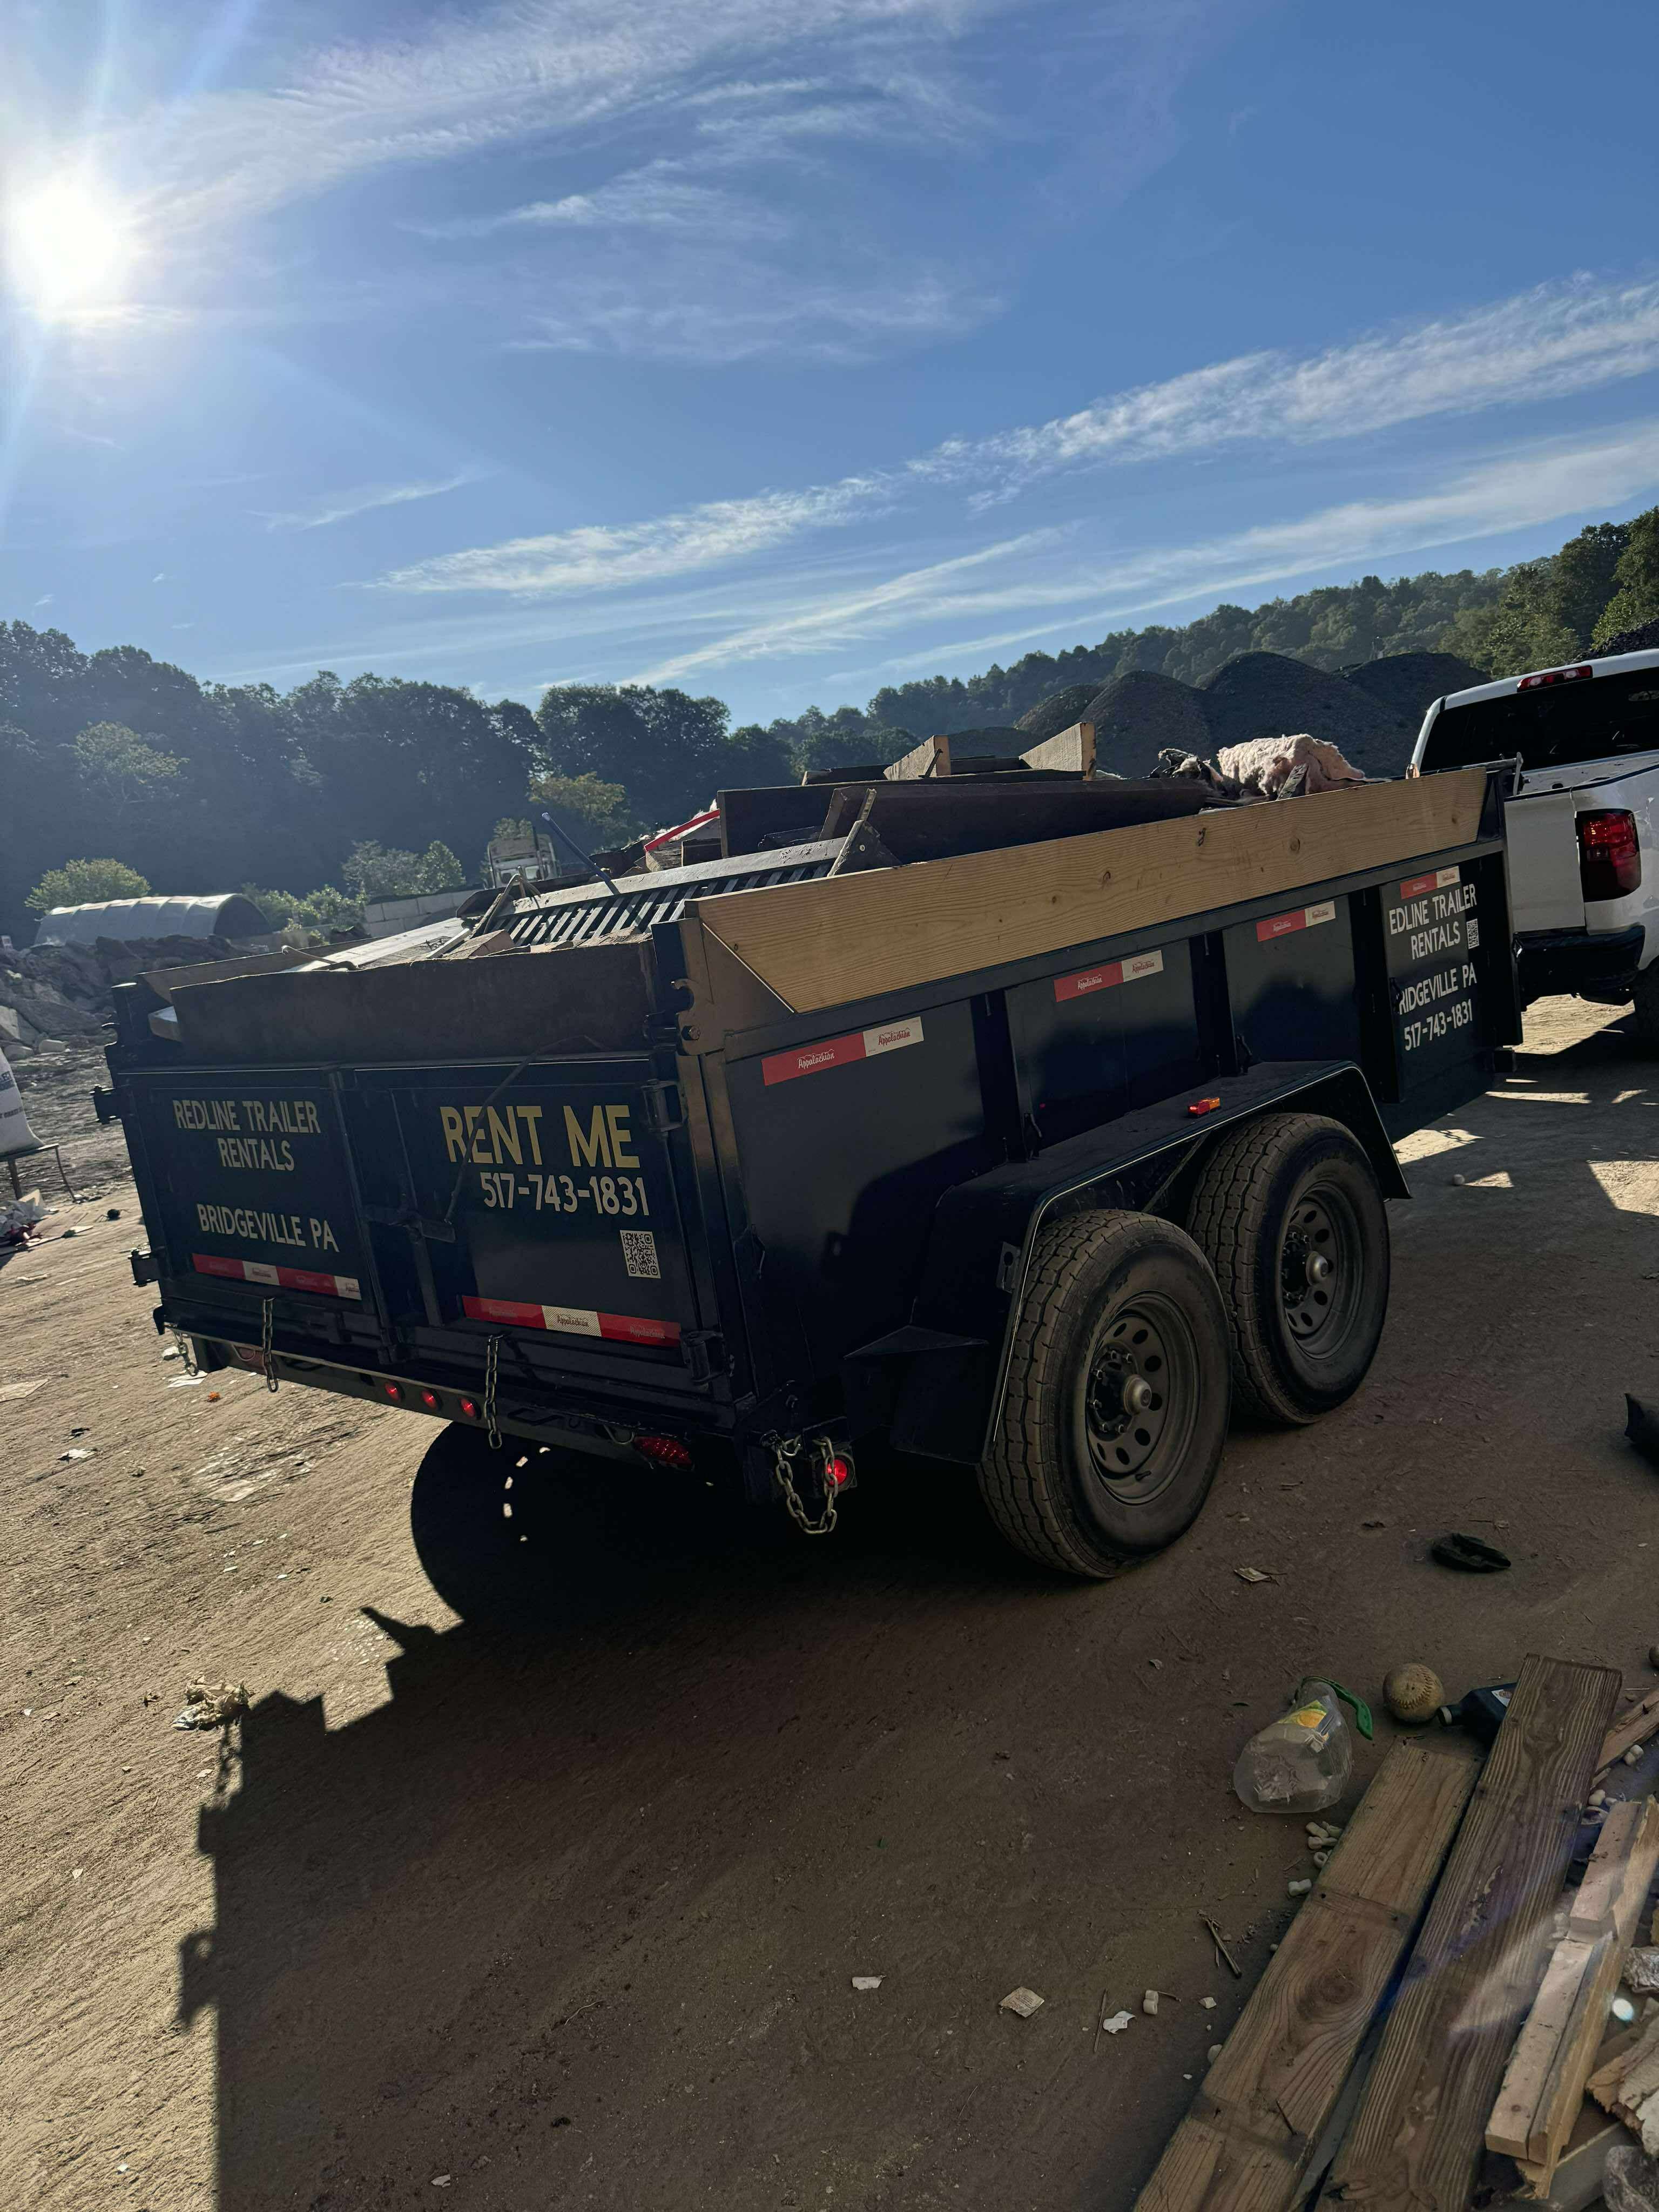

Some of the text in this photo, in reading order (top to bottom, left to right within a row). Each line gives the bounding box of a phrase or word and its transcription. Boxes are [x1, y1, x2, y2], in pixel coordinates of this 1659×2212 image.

[1389, 884, 1477, 935] EDLINE TRAILER
[1411, 921, 1461, 960] RENTALS
[1462, 962, 1478, 988] PA
[878, 1030, 911, 1047] Appalachian
[1404, 999, 1473, 1051] 517-743-1831
[798, 1051, 835, 1069] Appalachian
[173, 1100, 321, 1134] REDLINE TRAILER
[218, 1138, 295, 1172] RENTALS
[439, 1105, 641, 1169] RENT ME
[480, 1172, 650, 1216] 517-743-1831
[197, 1204, 340, 1253] BRIDGEVILLE PA
